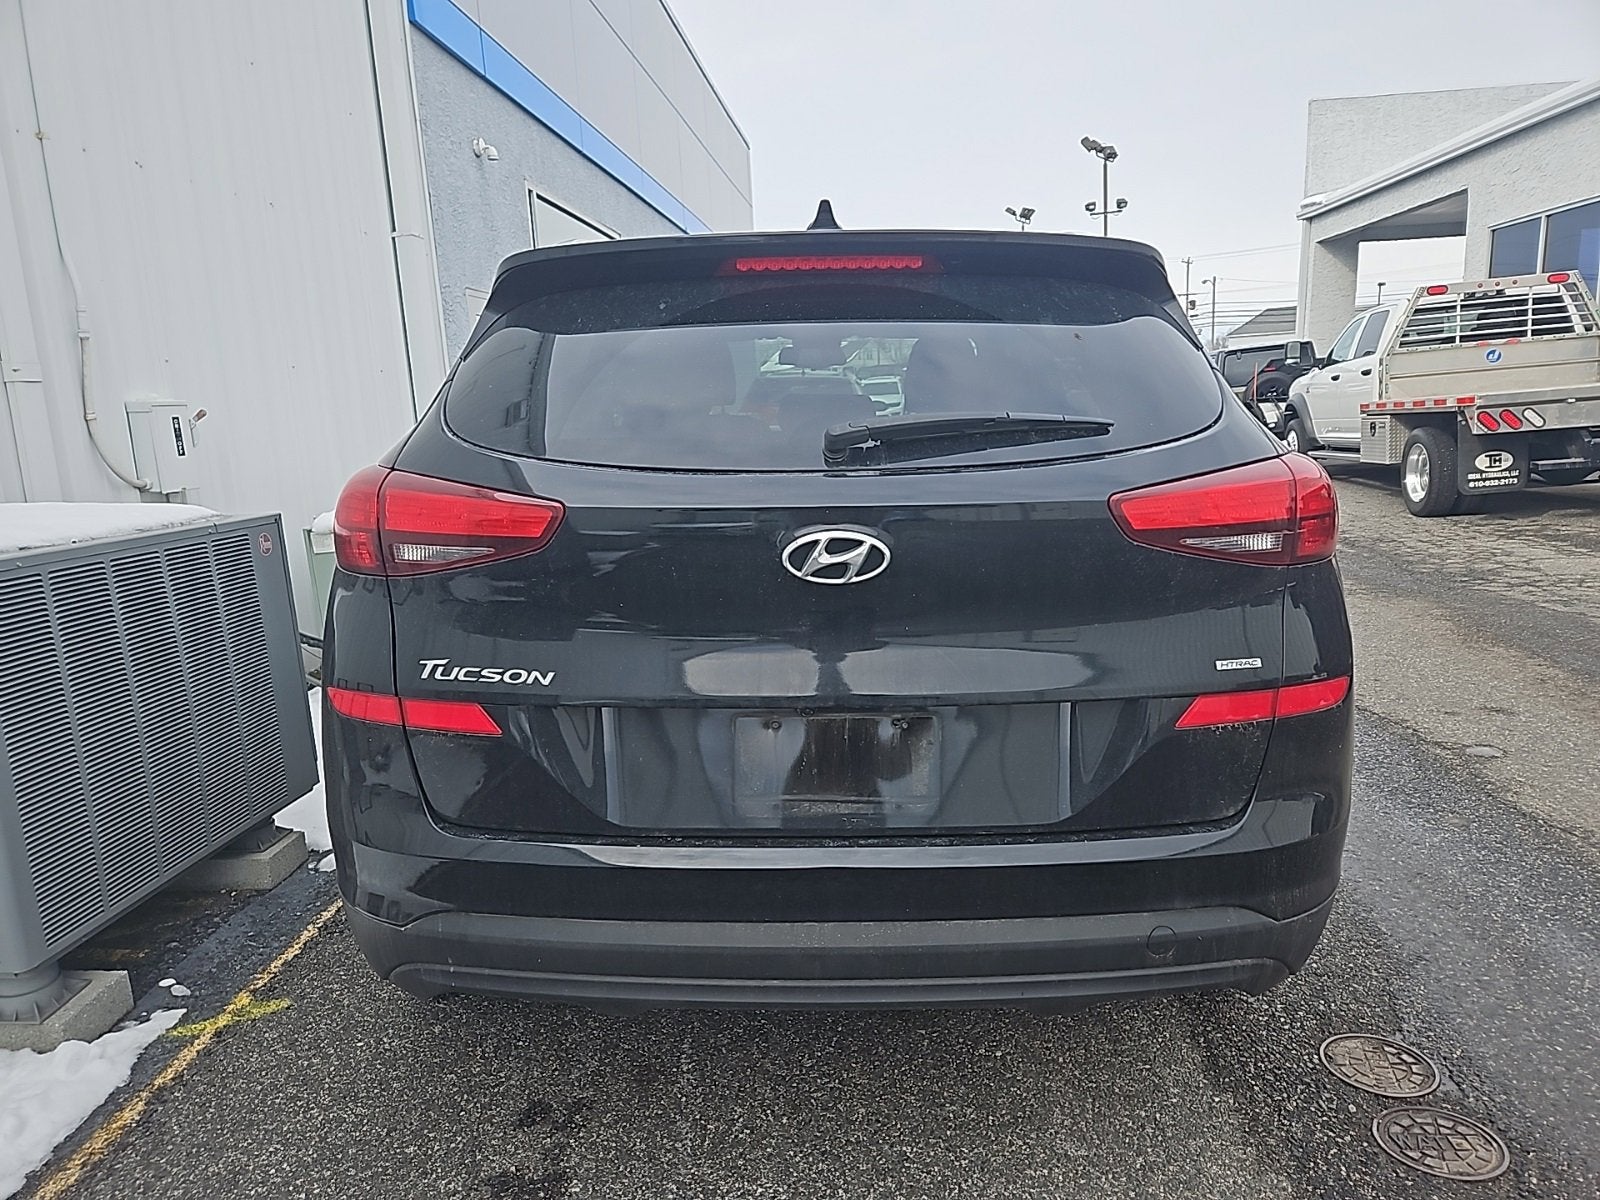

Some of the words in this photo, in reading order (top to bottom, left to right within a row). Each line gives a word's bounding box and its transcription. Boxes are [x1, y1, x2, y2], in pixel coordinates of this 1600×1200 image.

[419, 658, 556, 686] TUCSON
[1219, 659, 1259, 669] HTRAC
[1388, 1132, 1493, 1152] WATER
